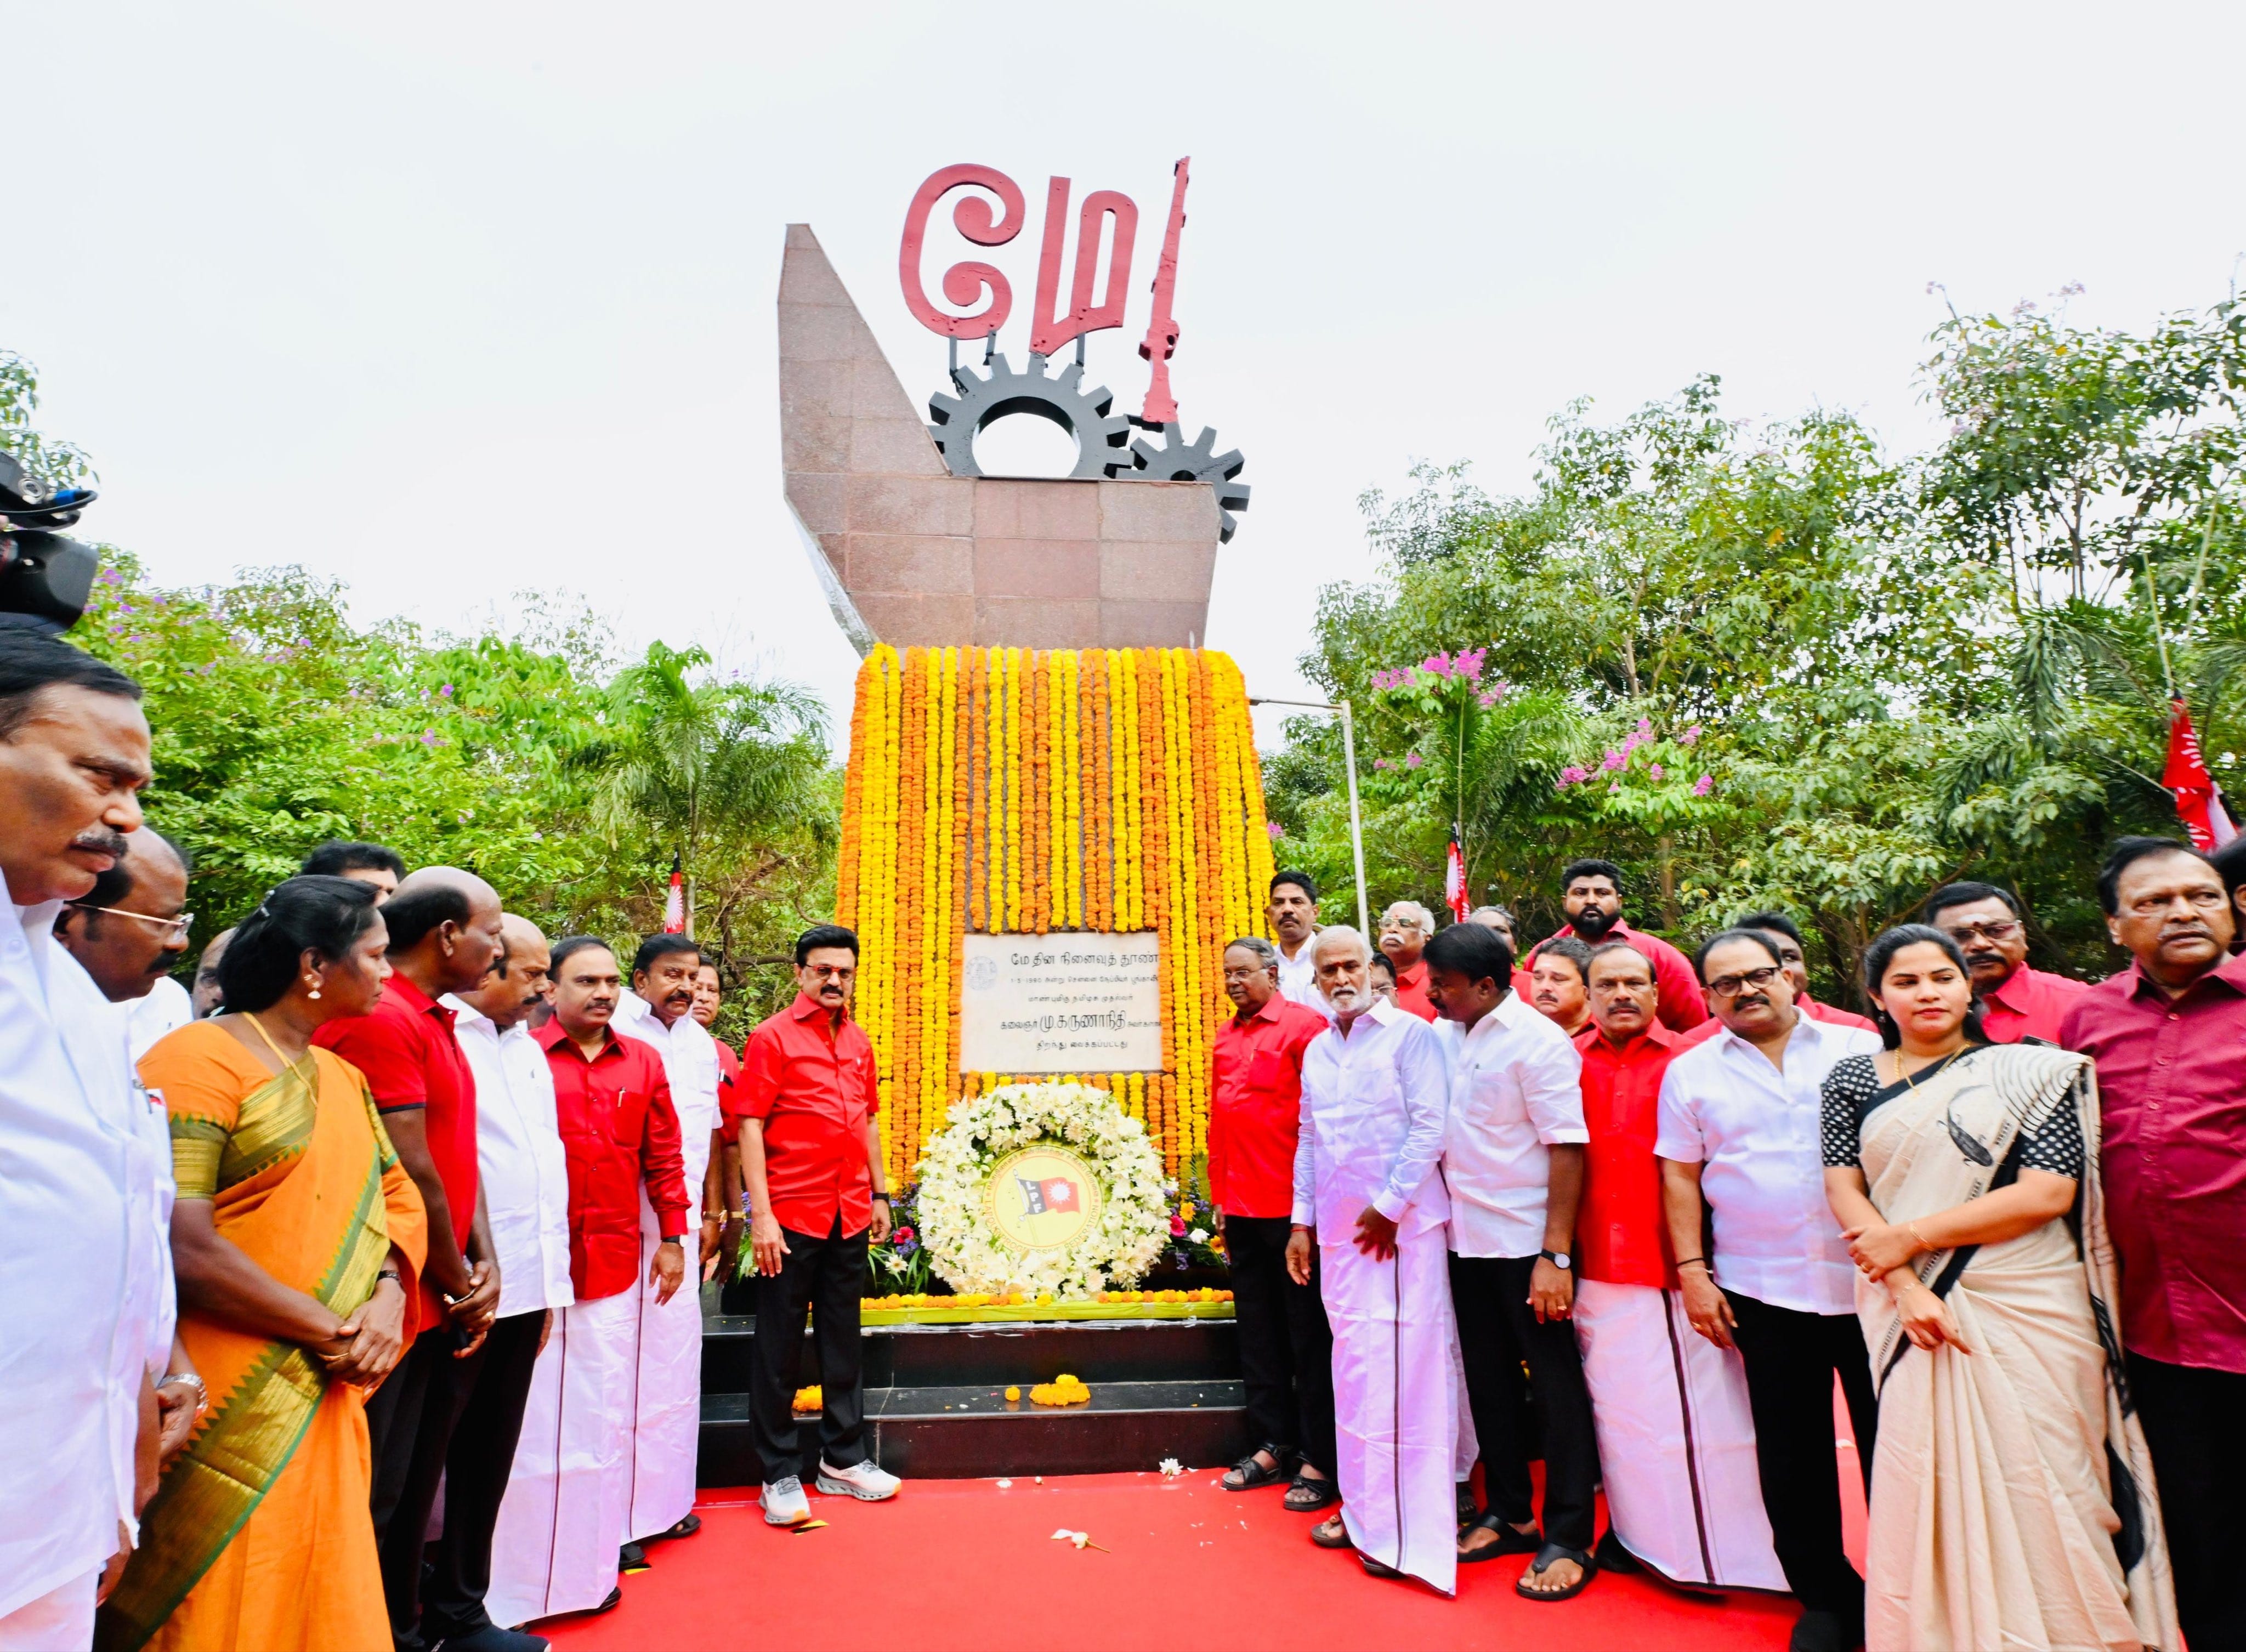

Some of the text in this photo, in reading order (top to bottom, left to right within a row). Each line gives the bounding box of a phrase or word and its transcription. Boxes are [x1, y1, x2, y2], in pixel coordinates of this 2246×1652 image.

[1011, 953, 1029, 965] மே
[1032, 952, 1055, 967] தின
[1060, 952, 1117, 967] நினைவுத்
[1028, 994, 1133, 1004] மாண்புமிகு தமிழக முதல்வர்
[1000, 1019, 1038, 1032] கலைஞர்
[1036, 1040, 1128, 1051] திறந்து வைக்கப்பட்டது
[1025, 1181, 1042, 1213] LPF
